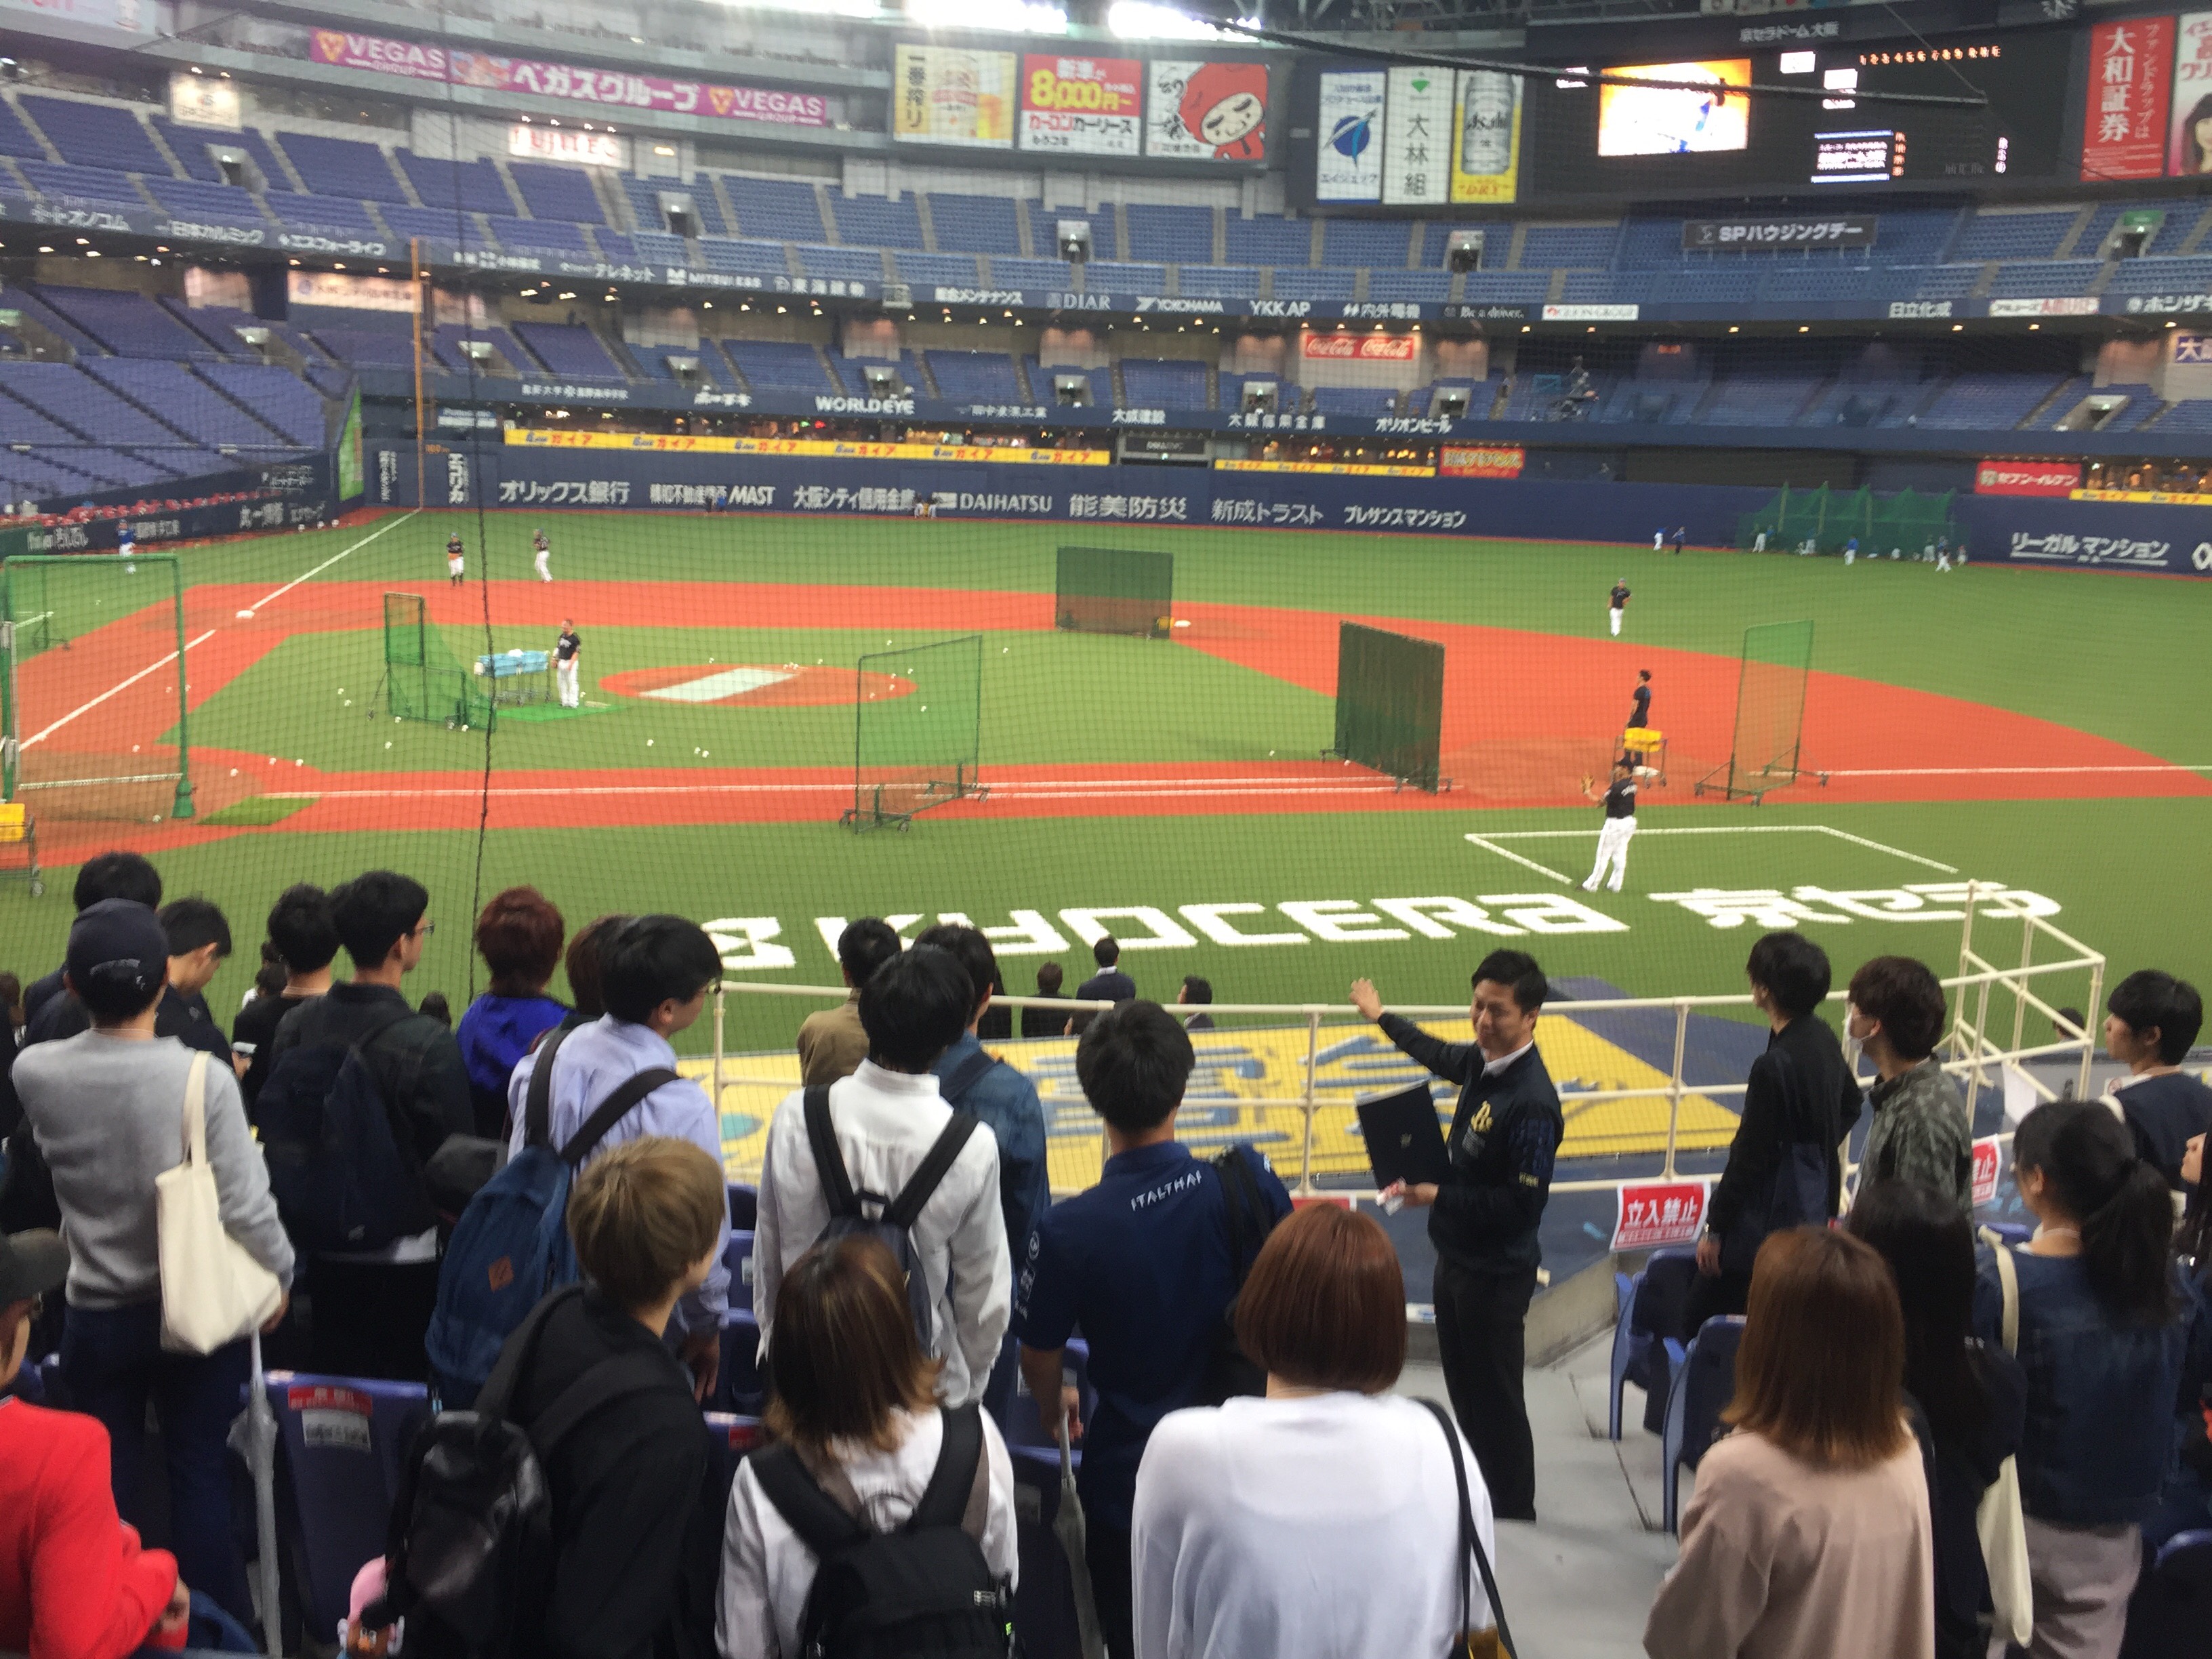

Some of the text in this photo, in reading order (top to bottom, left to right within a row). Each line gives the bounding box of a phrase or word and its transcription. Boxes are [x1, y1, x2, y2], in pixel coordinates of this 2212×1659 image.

[346, 33, 447, 69] VEGAS
[514, 62, 701, 111] ベガスグループ
[2097, 26, 2136, 143] 大和証券
[734, 89, 823, 117] VEGAS
[1404, 113, 1429, 196] 大林組
[1063, 292, 1111, 310] DIAR
[1156, 298, 1224, 313] YOKOHAMA
[1888, 301, 1952, 319] 日立化成
[1228, 413, 1326, 431] 大阪信用金庫
[498, 480, 630, 505] オリックス銀行
[728, 485, 776, 506] MAST
[794, 485, 916, 512] 大阪シティ信用金庫
[960, 493, 1052, 513] DAIHATSU
[1069, 493, 1187, 520] 能美防災
[1211, 498, 1324, 525] 新成トラスト
[1343, 504, 1467, 529] プレサンスマンション
[1647, 880, 2062, 929] 京セラ
[815, 892, 1631, 962] KYOCERA
[1130, 1169, 1202, 1212] ITALTHAI
[1624, 1195, 1699, 1229] 立入禁止
